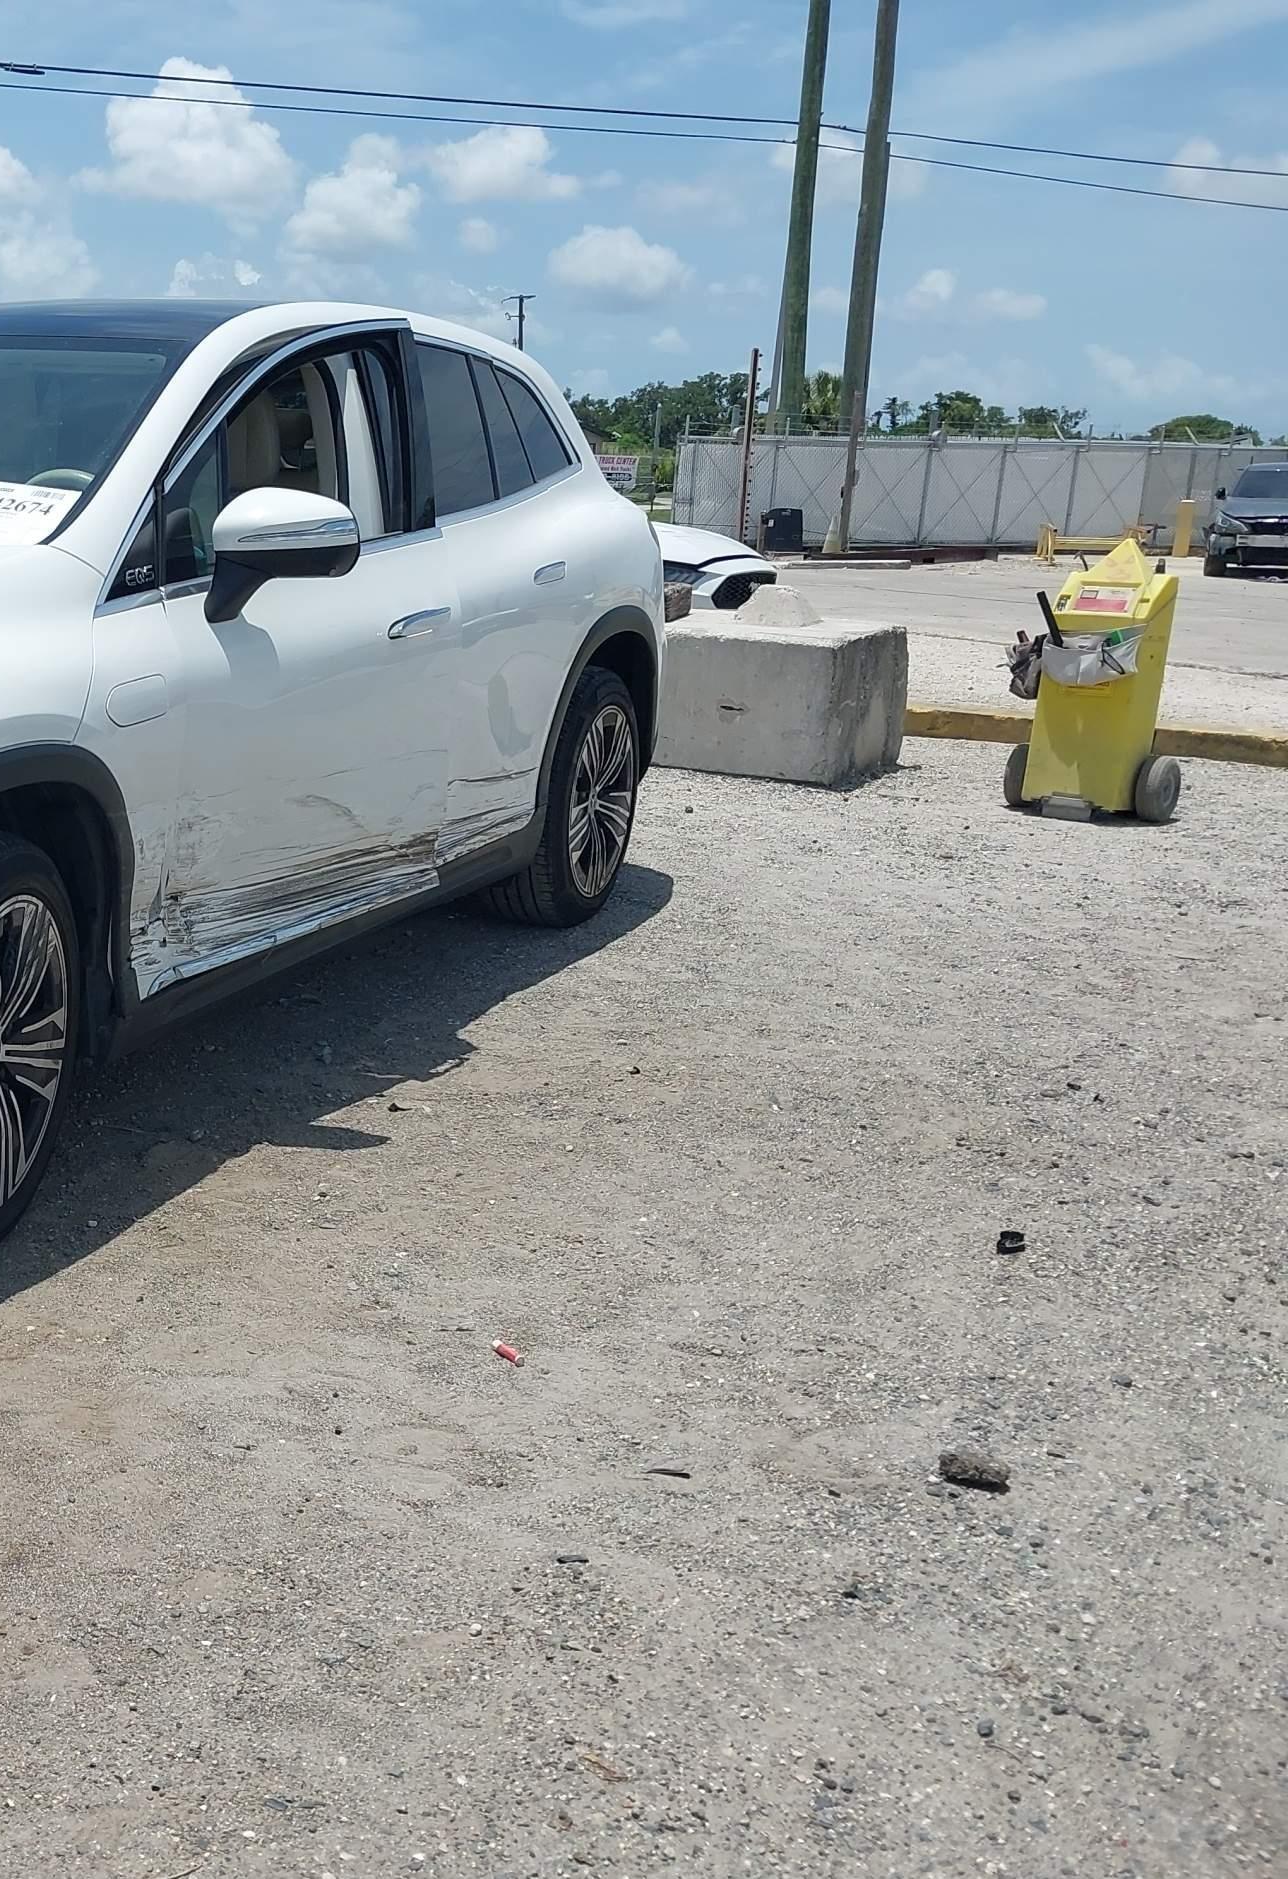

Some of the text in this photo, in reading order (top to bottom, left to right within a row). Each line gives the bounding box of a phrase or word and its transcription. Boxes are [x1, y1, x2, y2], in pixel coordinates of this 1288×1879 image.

[599, 456, 638, 466] TRUCK CENTER
[125, 564, 155, 586] EQS
